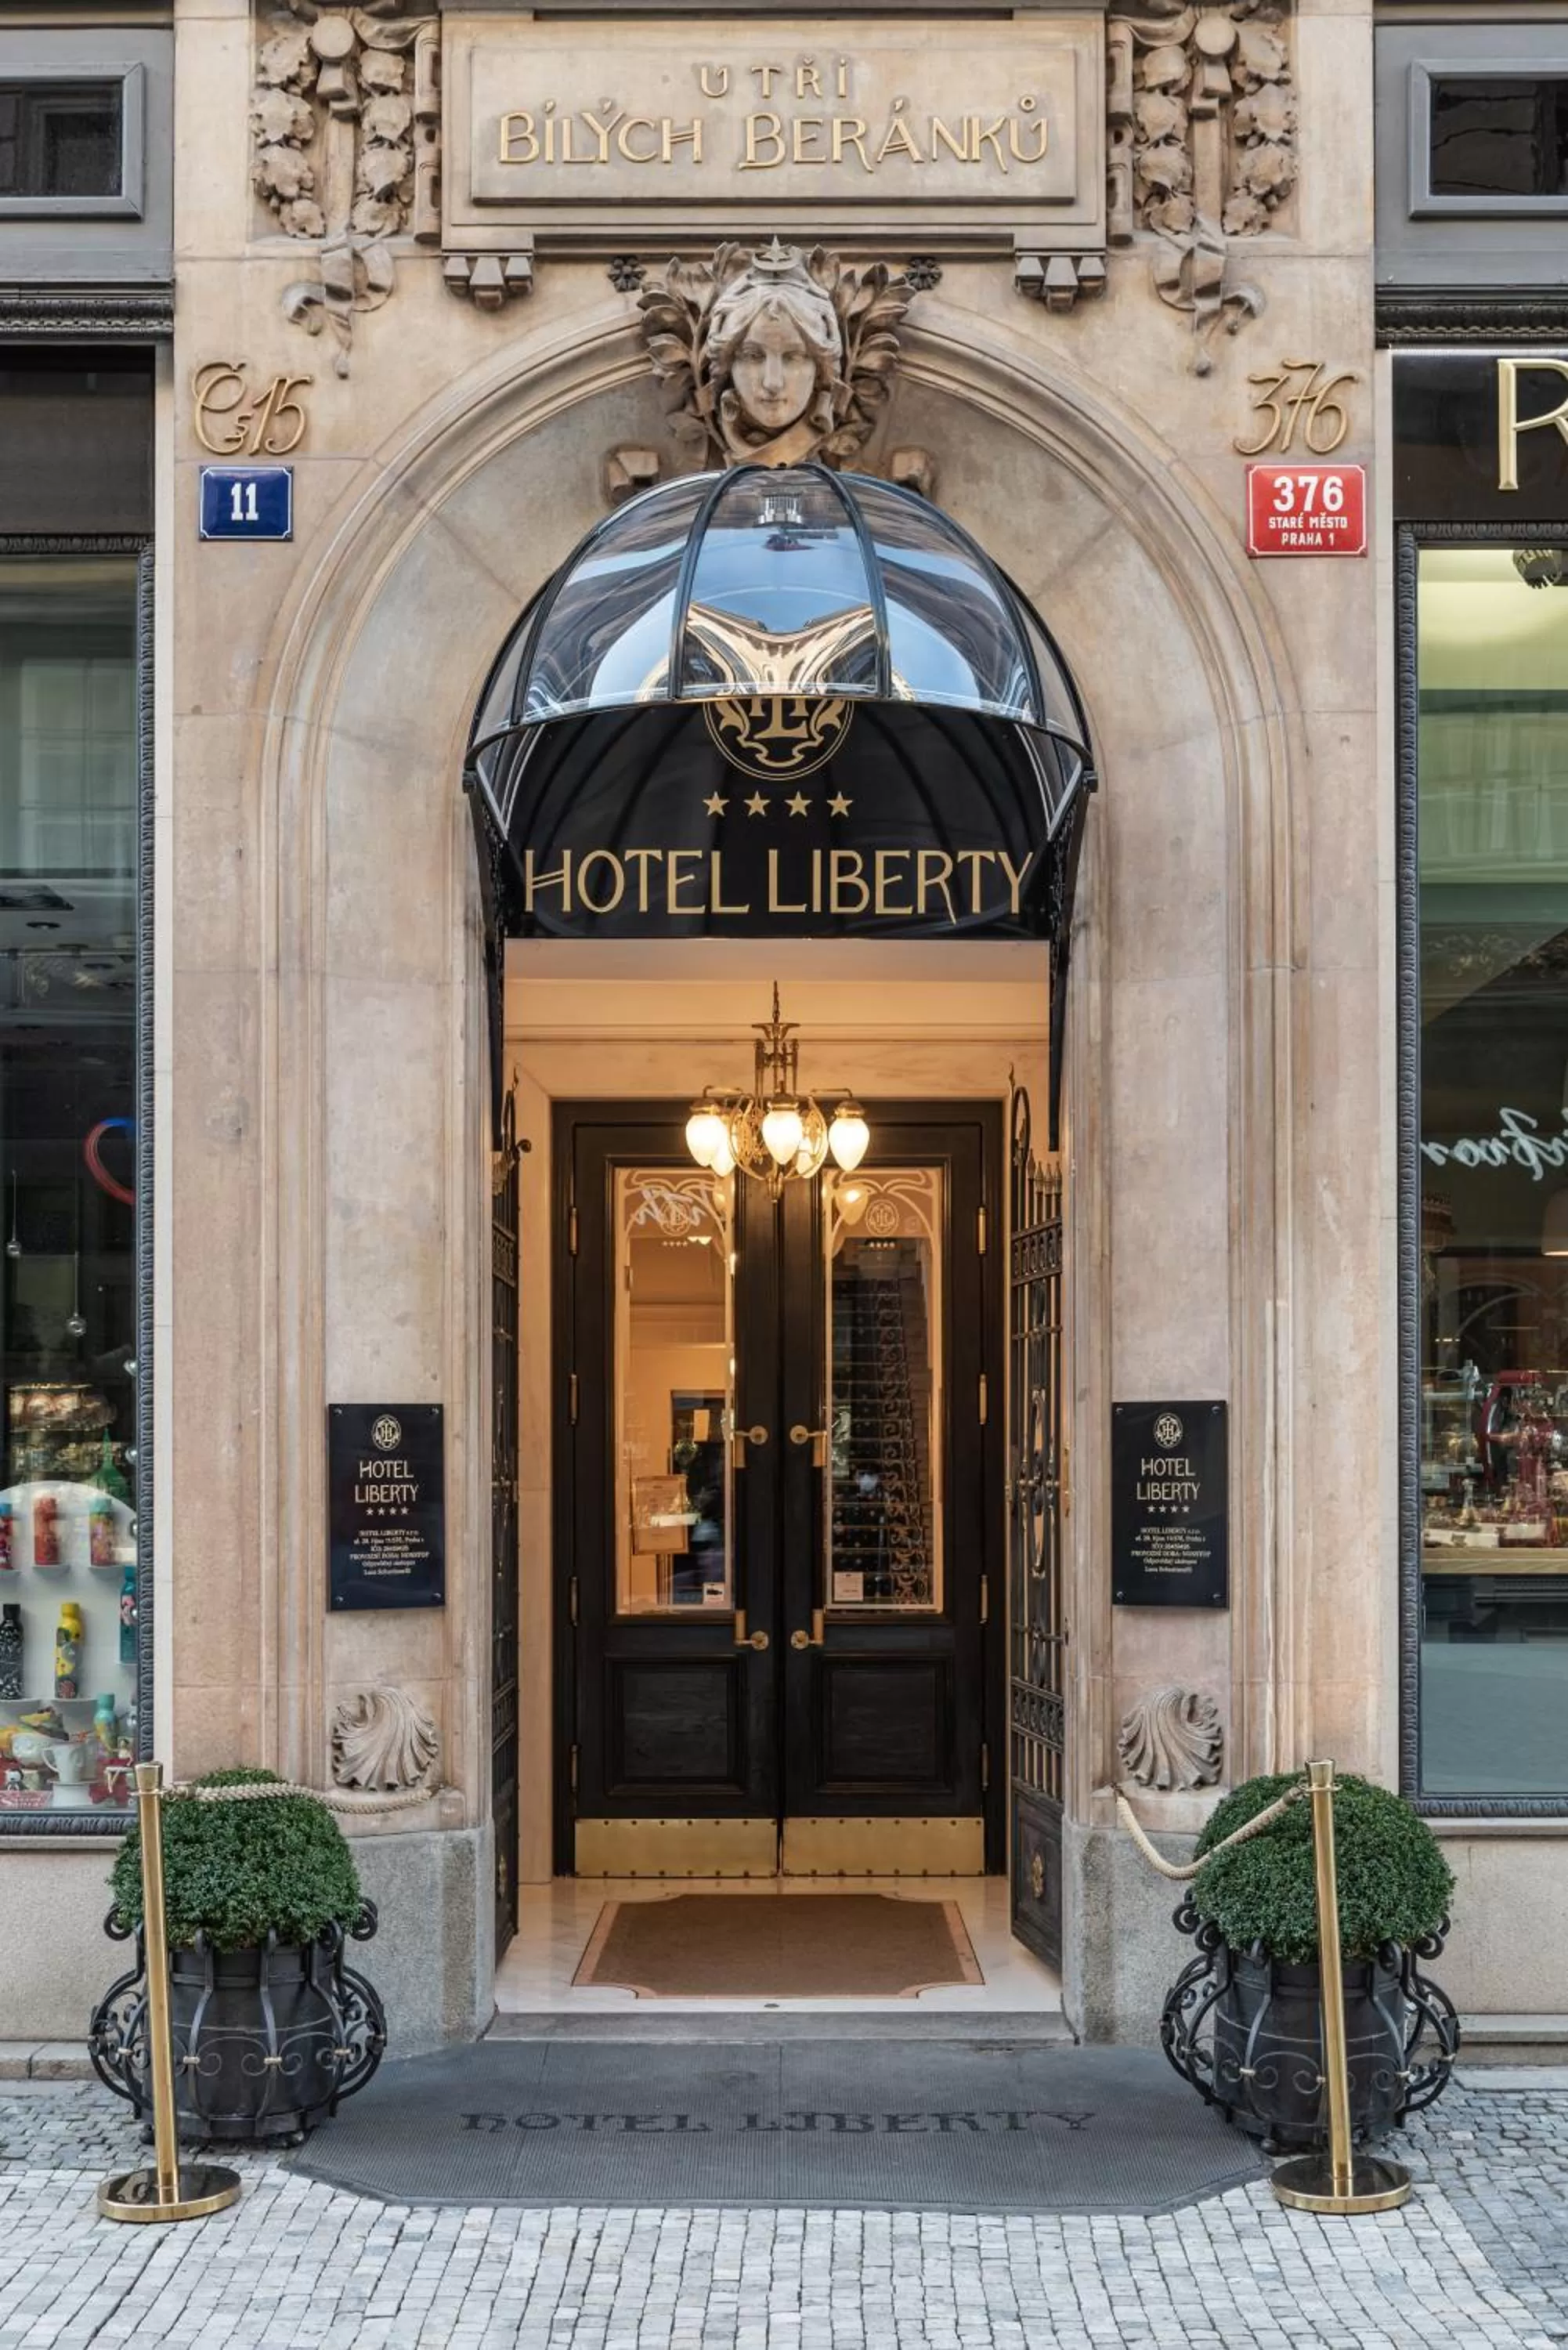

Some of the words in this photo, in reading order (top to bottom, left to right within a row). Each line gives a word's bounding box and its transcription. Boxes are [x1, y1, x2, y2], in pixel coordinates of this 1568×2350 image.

[699, 67, 728, 99] U
[499, 99, 703, 164] BÍLÝCH
[739, 95, 1050, 174] BERÁNKŮ
[1232, 357, 1360, 454] 376
[230, 482, 259, 521] 11
[1272, 475, 1345, 512] 376
[1268, 512, 1304, 530] STARÉ
[1309, 512, 1348, 530] MĚSTO
[1281, 533, 1324, 547] PRAHA
[1327, 533, 1335, 546] 1
[524, 849, 750, 915] HOTEL
[768, 849, 1033, 925] LIBERTY
[359, 1459, 414, 1480] HOTEL
[1140, 1458, 1196, 1477] HOTEL
[354, 1484, 419, 1504] LIBERTY
[1136, 1481, 1201, 1502] LIBERTY
[736, 2111, 1096, 2134] LIBERTY
